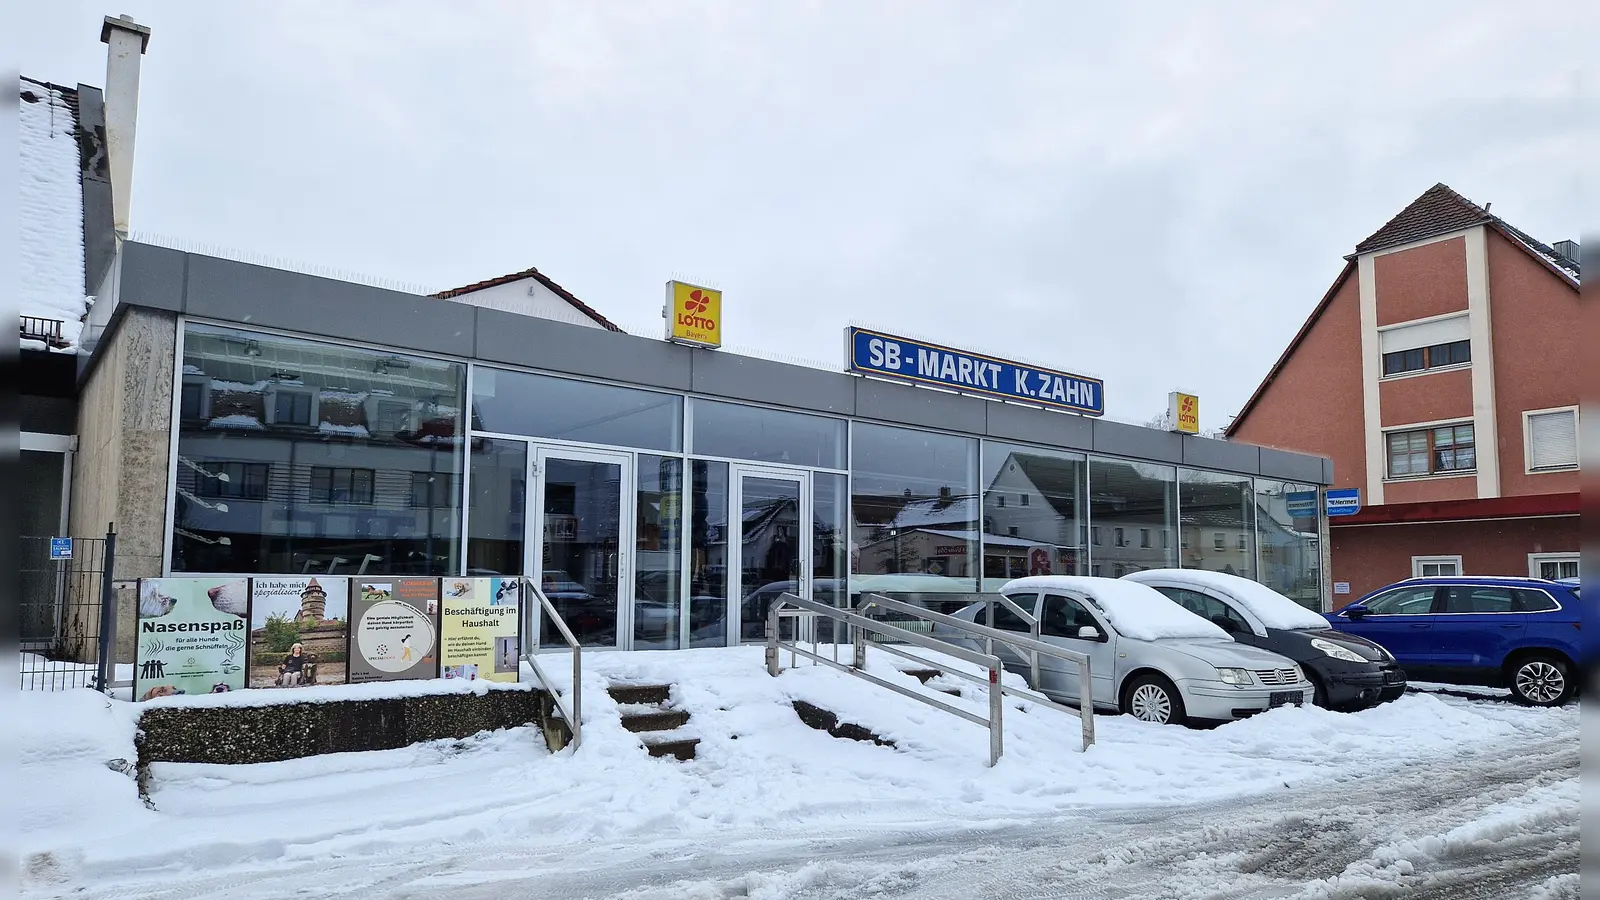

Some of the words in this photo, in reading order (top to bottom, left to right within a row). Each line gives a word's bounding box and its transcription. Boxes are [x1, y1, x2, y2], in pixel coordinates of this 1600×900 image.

[678, 313, 715, 331] LOTTO
[1179, 413, 1196, 424] LOTTO
[256, 580, 268, 588] Ich
[270, 581, 287, 589] habe
[254, 588, 302, 598] spezialisiert
[444, 607, 505, 616] Beschäftigung
[142, 619, 244, 634] Nasenspaß
[462, 619, 499, 628] Haushalt
